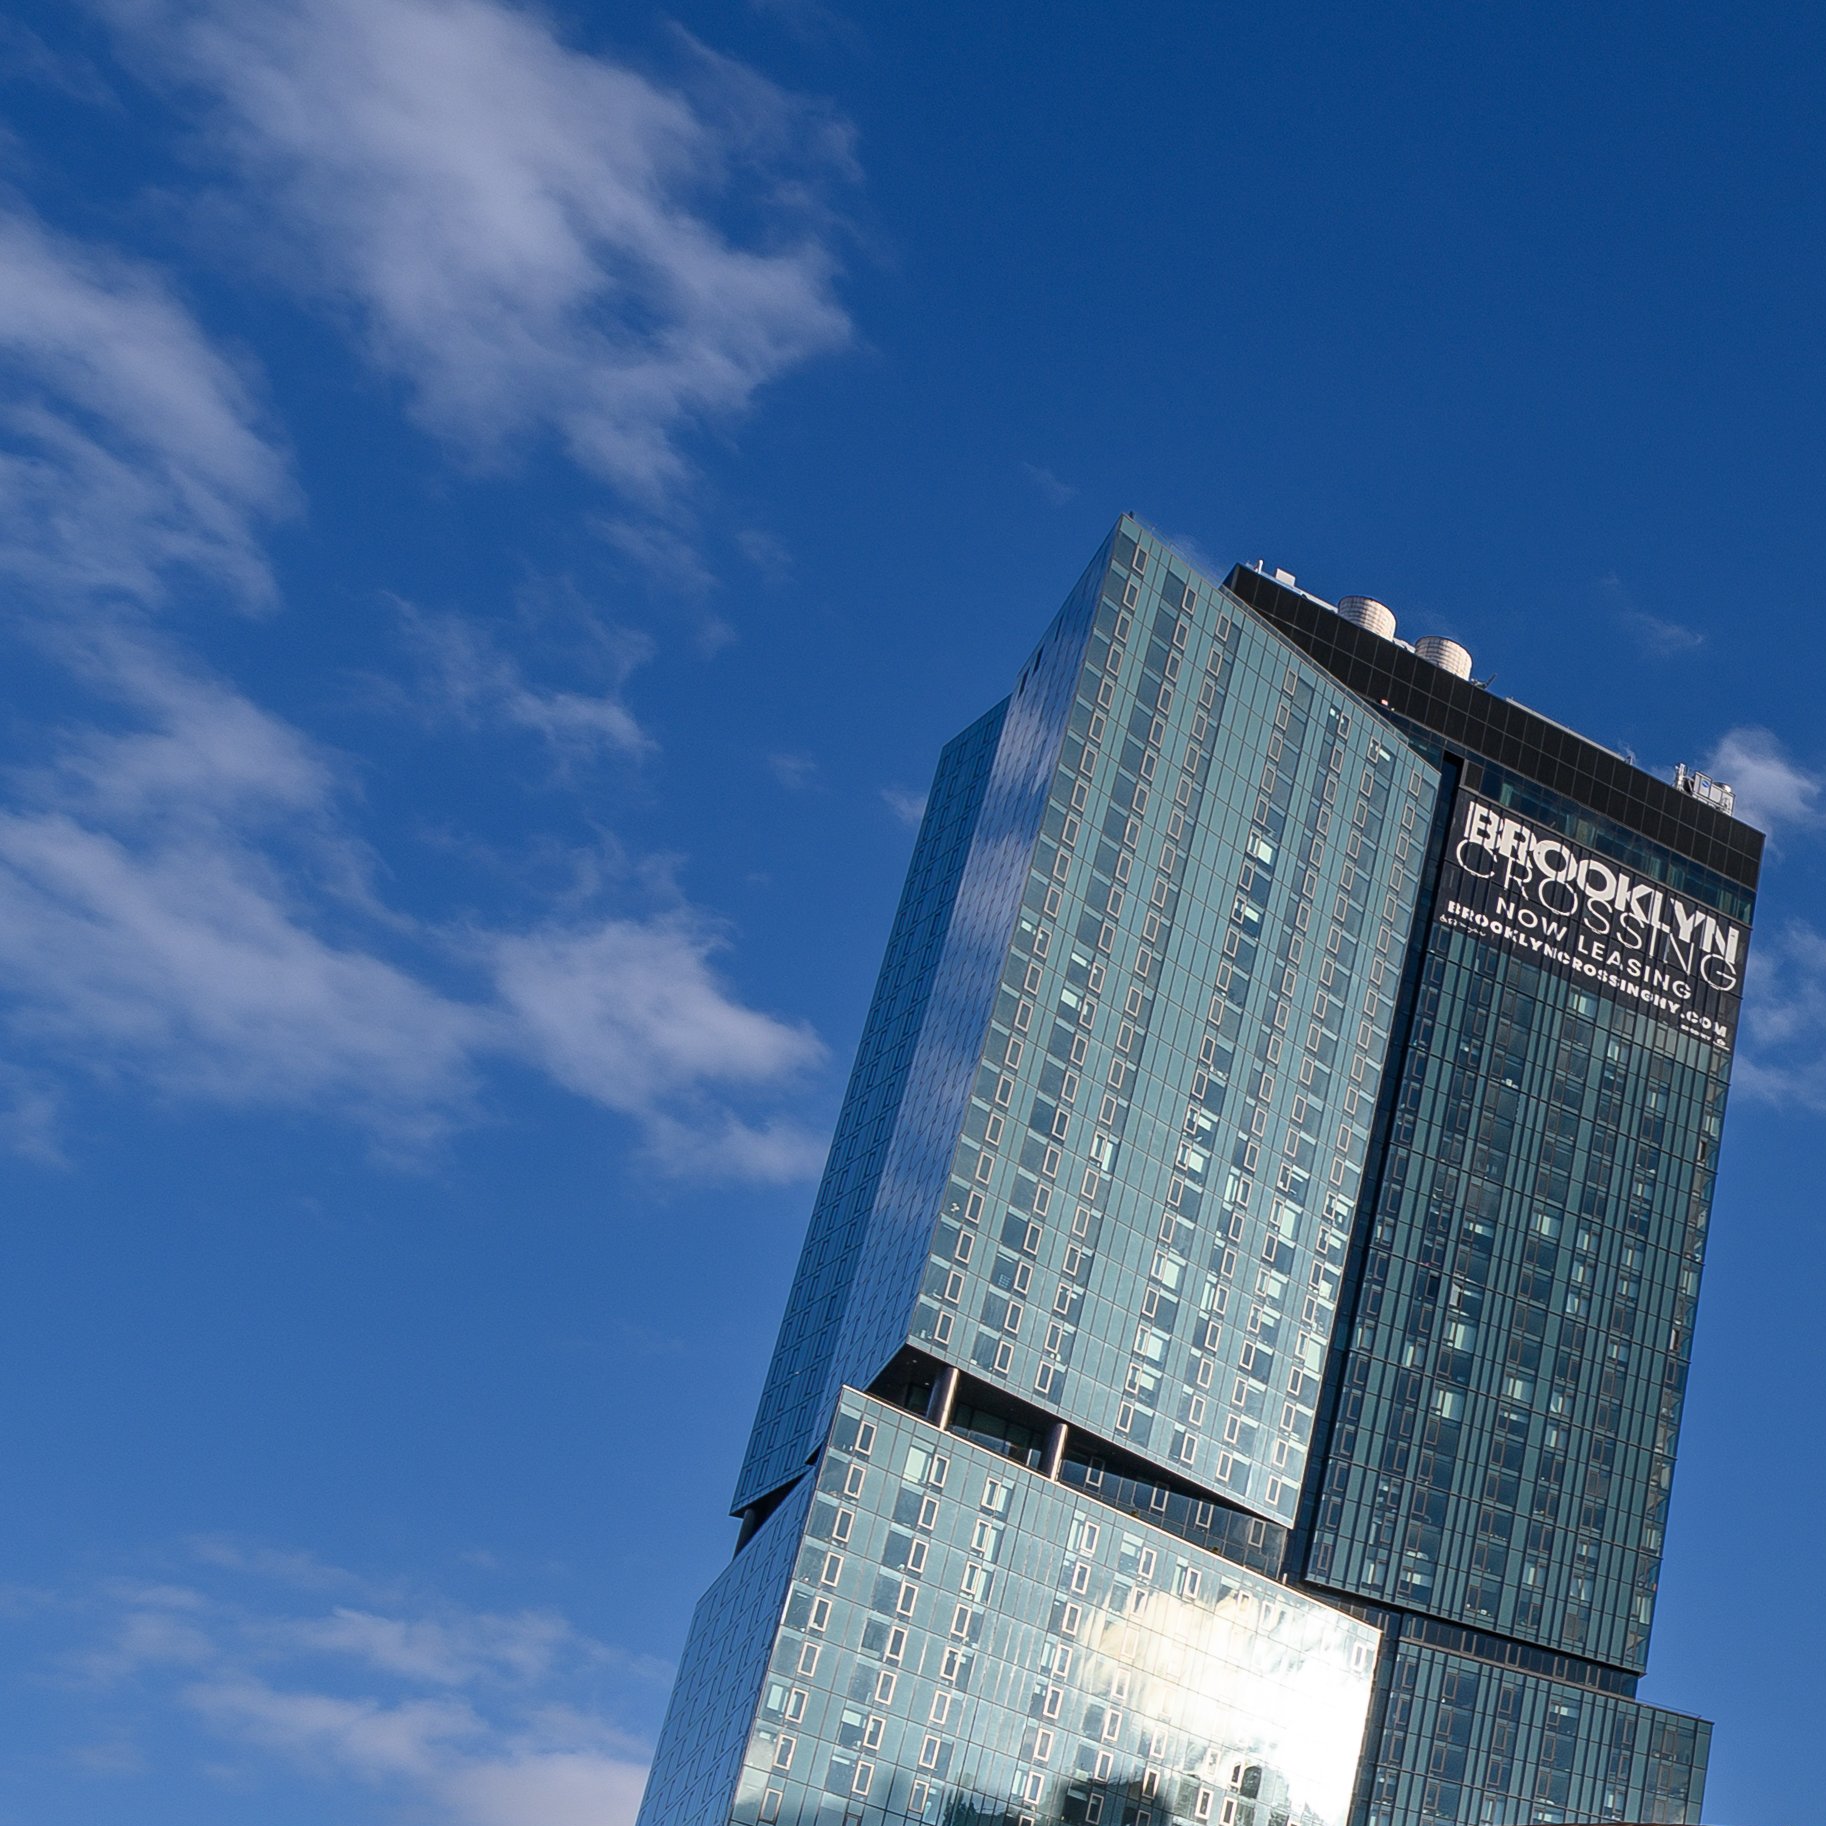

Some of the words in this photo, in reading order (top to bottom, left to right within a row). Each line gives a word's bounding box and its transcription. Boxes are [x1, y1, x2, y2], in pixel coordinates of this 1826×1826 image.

[1456, 839, 1736, 991] CROSSING
[1463, 801, 1739, 963] BROOKLYN
[1496, 897, 1568, 941] NOW
[1577, 934, 1692, 999] LEASING
